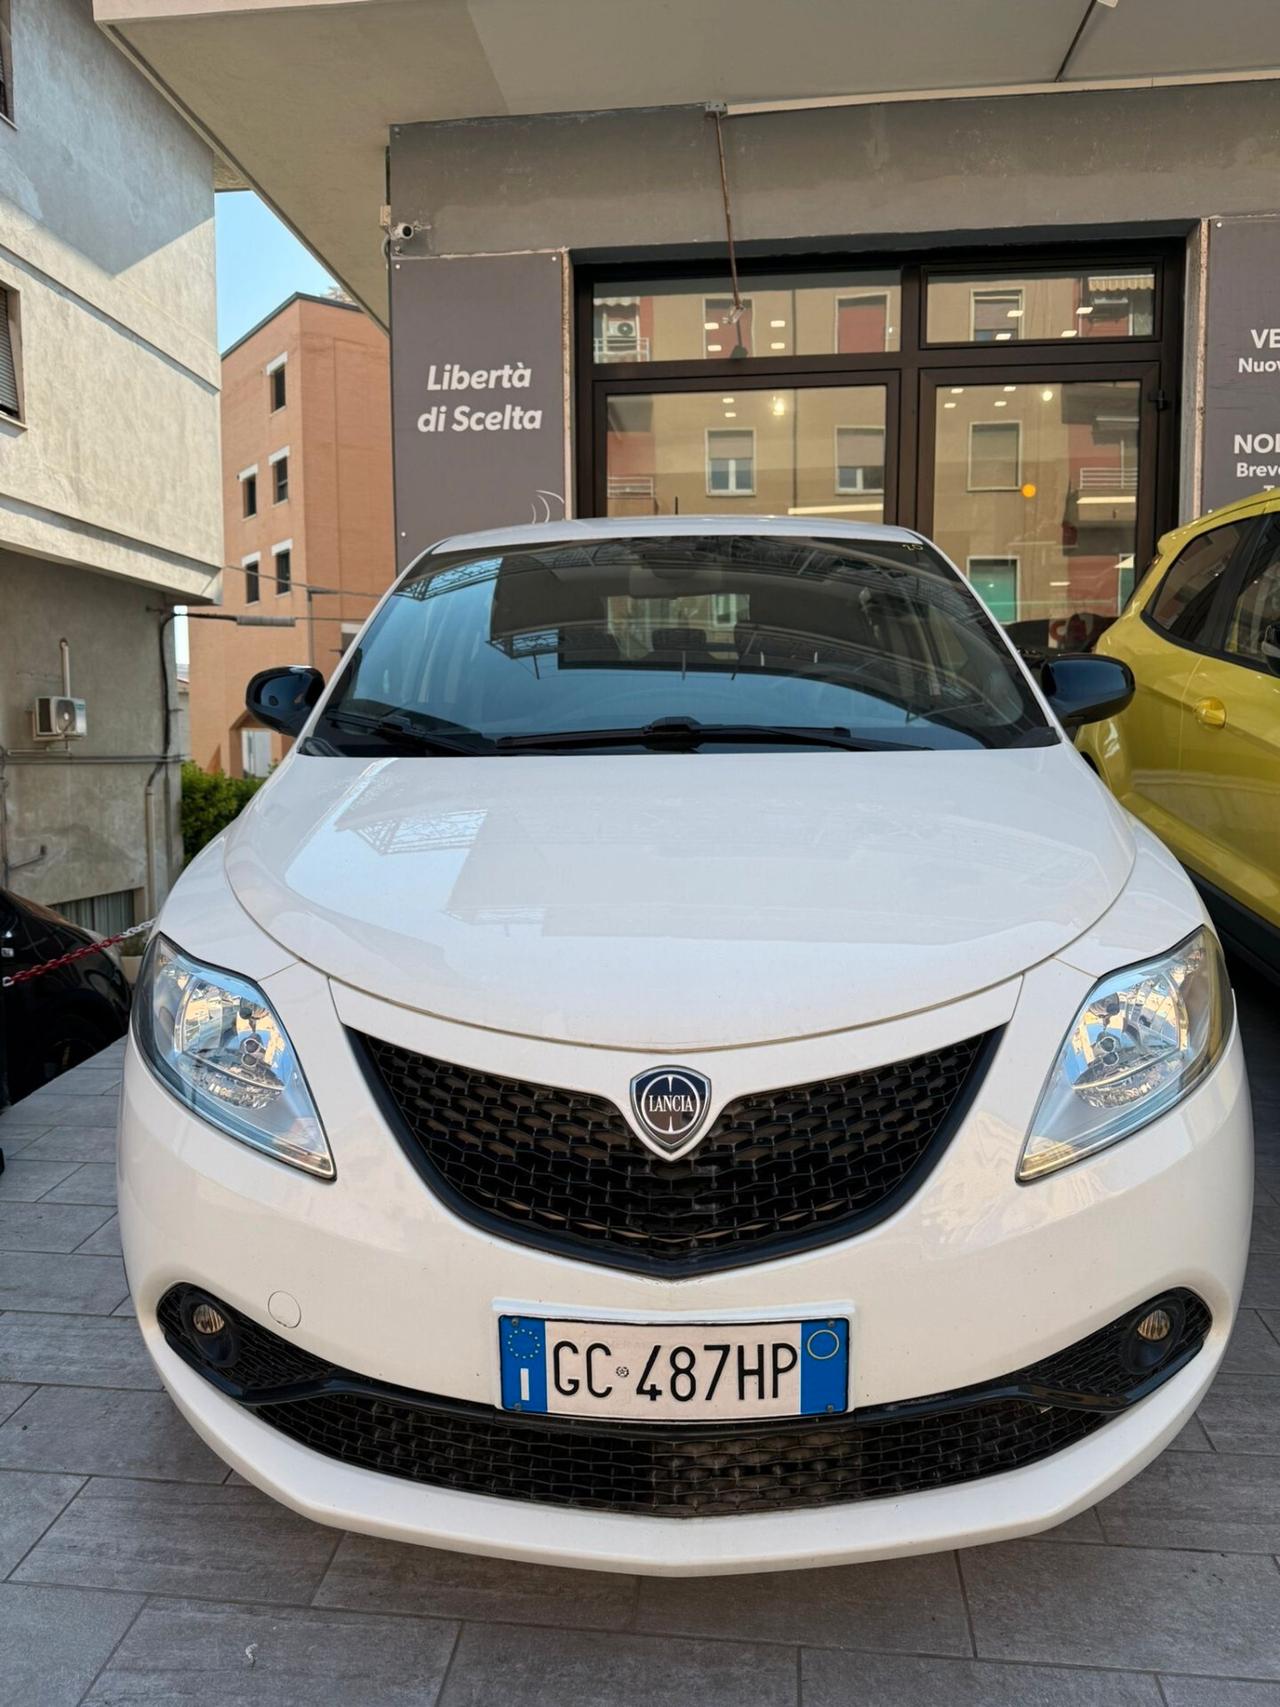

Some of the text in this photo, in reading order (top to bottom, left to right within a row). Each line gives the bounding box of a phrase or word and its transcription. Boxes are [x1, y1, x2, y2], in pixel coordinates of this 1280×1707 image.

[1250, 328, 1280, 349] VE
[427, 362, 532, 391] Libertà
[417, 404, 543, 432] di Scelta
[1236, 462, 1280, 477] Brev
[649, 1094, 694, 1112] LANCIA
[520, 1368, 530, 1400] I
